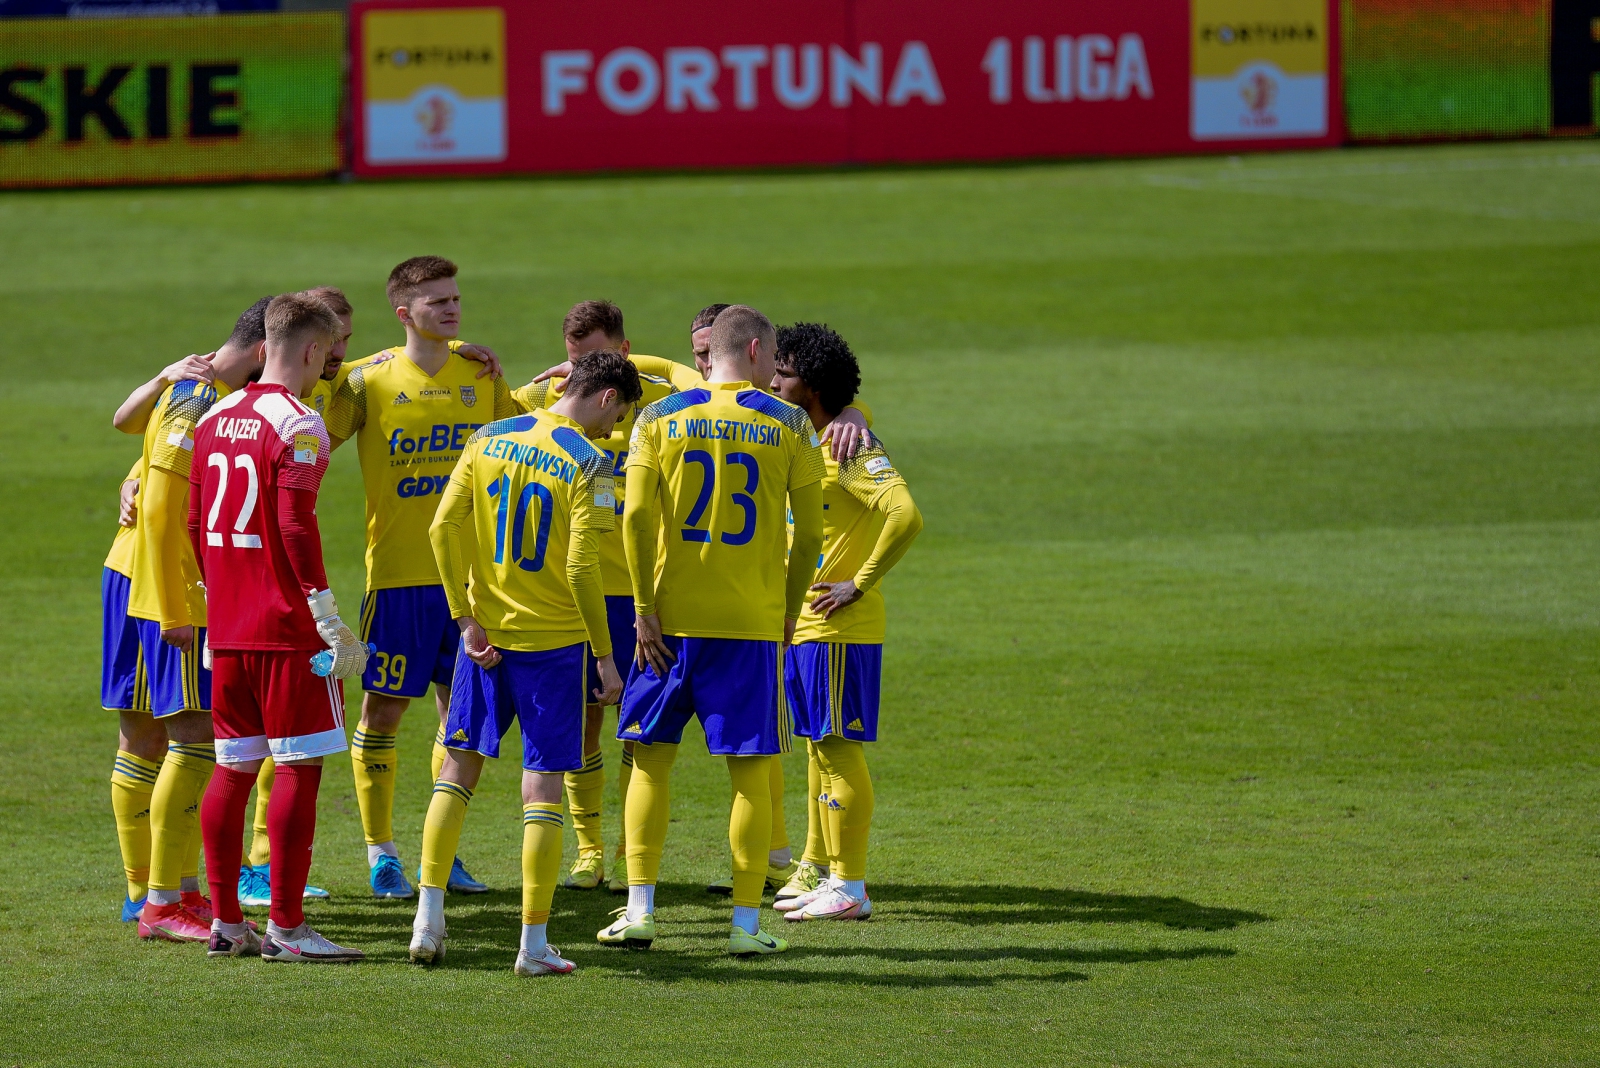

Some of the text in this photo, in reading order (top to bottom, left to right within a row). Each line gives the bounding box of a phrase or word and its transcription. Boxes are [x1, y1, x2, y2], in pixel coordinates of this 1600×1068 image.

[0, 64, 242, 142] SKIE
[542, 33, 1154, 116] FORTUNA 1 LIGA
[215, 417, 262, 444] KAJZER
[483, 438, 578, 485] LETNIOWSKI
[668, 418, 781, 447] R. WOLSZTYŃSKI
[206, 452, 263, 548] 22
[487, 472, 554, 572] 10
[681, 449, 760, 546] 23
[372, 651, 407, 690] 39
